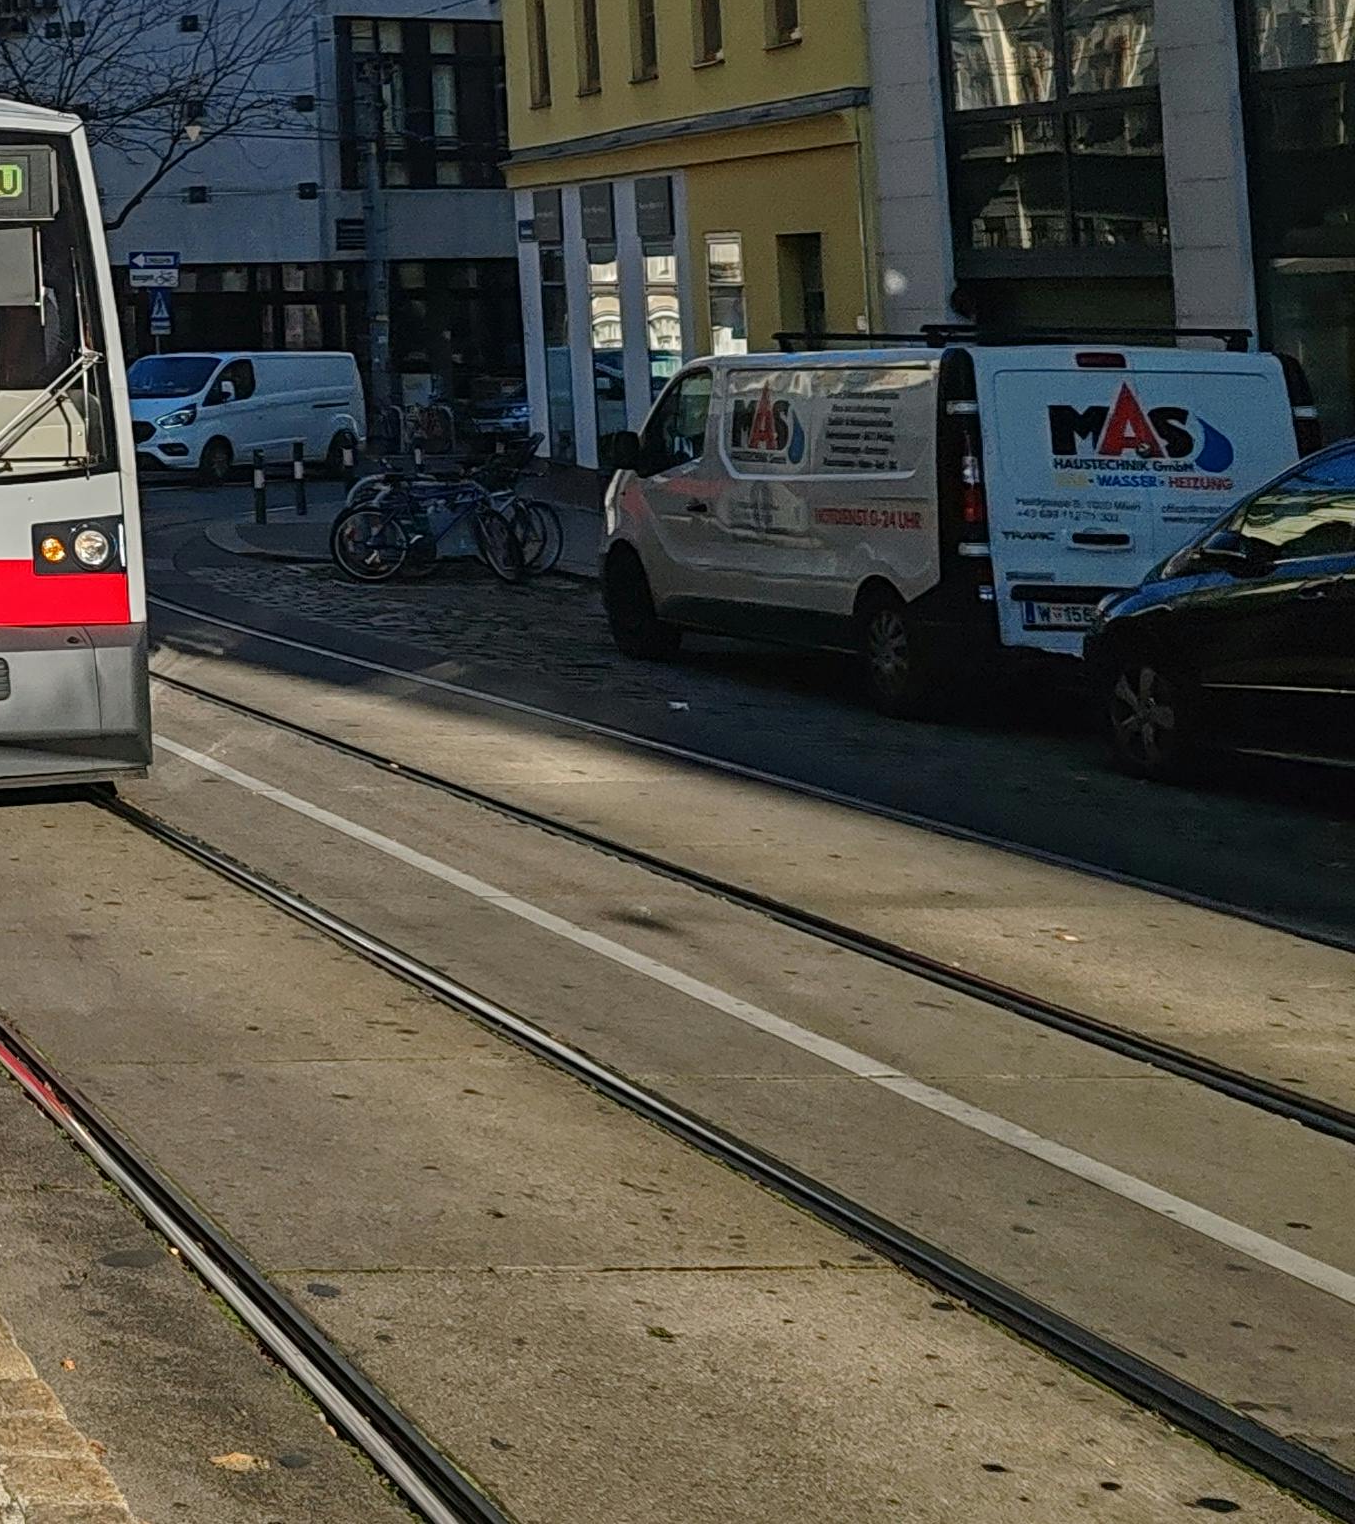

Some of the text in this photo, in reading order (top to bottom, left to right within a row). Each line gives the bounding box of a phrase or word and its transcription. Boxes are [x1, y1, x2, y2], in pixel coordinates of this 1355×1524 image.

[731, 379, 790, 450] MAS
[1047, 380, 1195, 459] MAS
[1053, 459, 1150, 472] HAUSTECHNIK
[1096, 475, 1158, 488] WASSER
[1168, 476, 1233, 491] HEIZUNG
